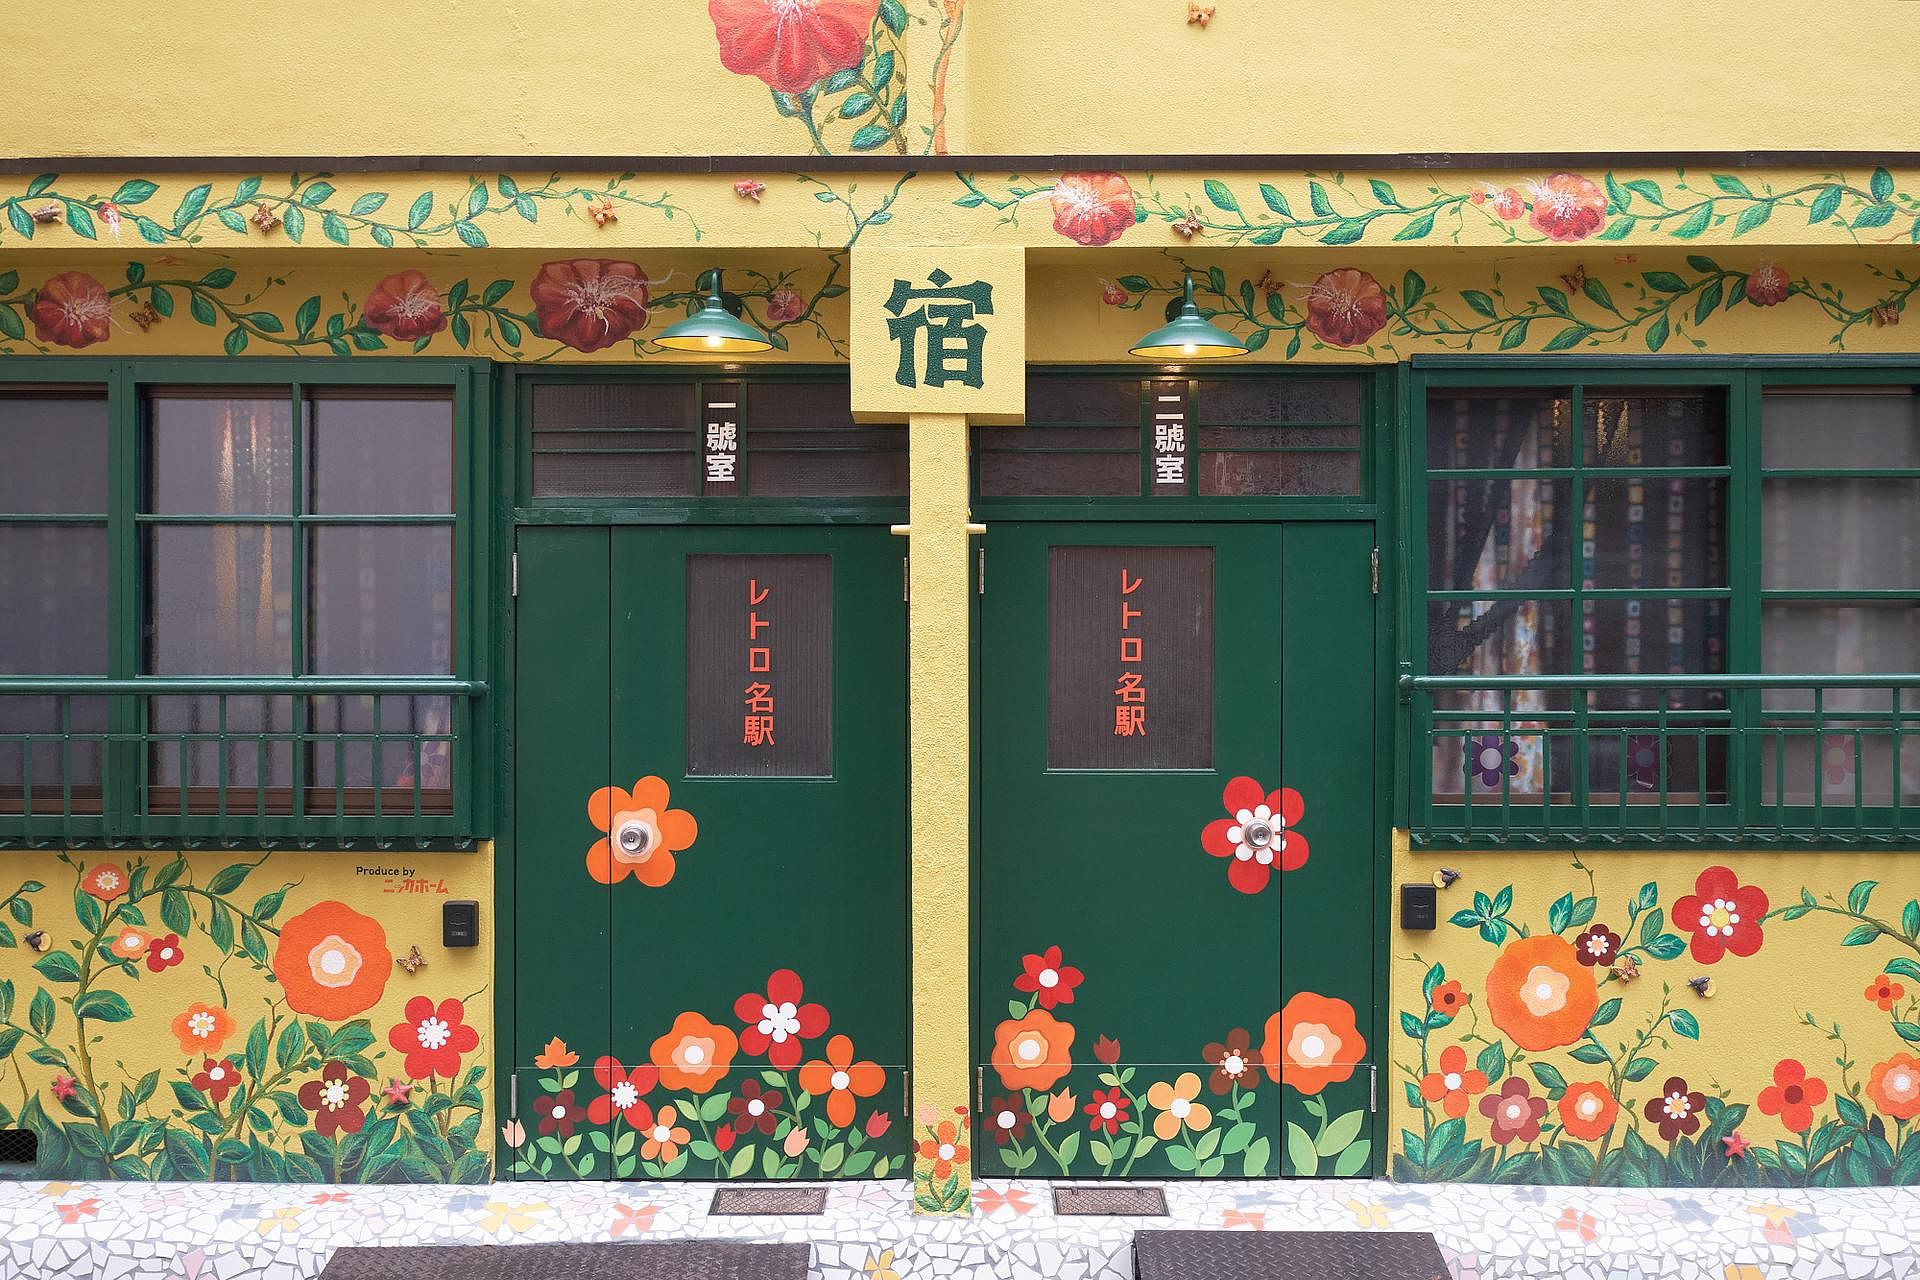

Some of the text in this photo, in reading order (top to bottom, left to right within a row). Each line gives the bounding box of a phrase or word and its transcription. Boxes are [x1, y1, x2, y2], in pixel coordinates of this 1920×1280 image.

[883, 268, 994, 390] 宿
[706, 402, 737, 482] 一號室
[1155, 395, 1185, 484] 二號室
[744, 579, 775, 746] レトロ名駅
[1114, 568, 1146, 737] レトロ名駅
[356, 866, 415, 877] Produce by
[383, 879, 449, 894] ニッカホーム
